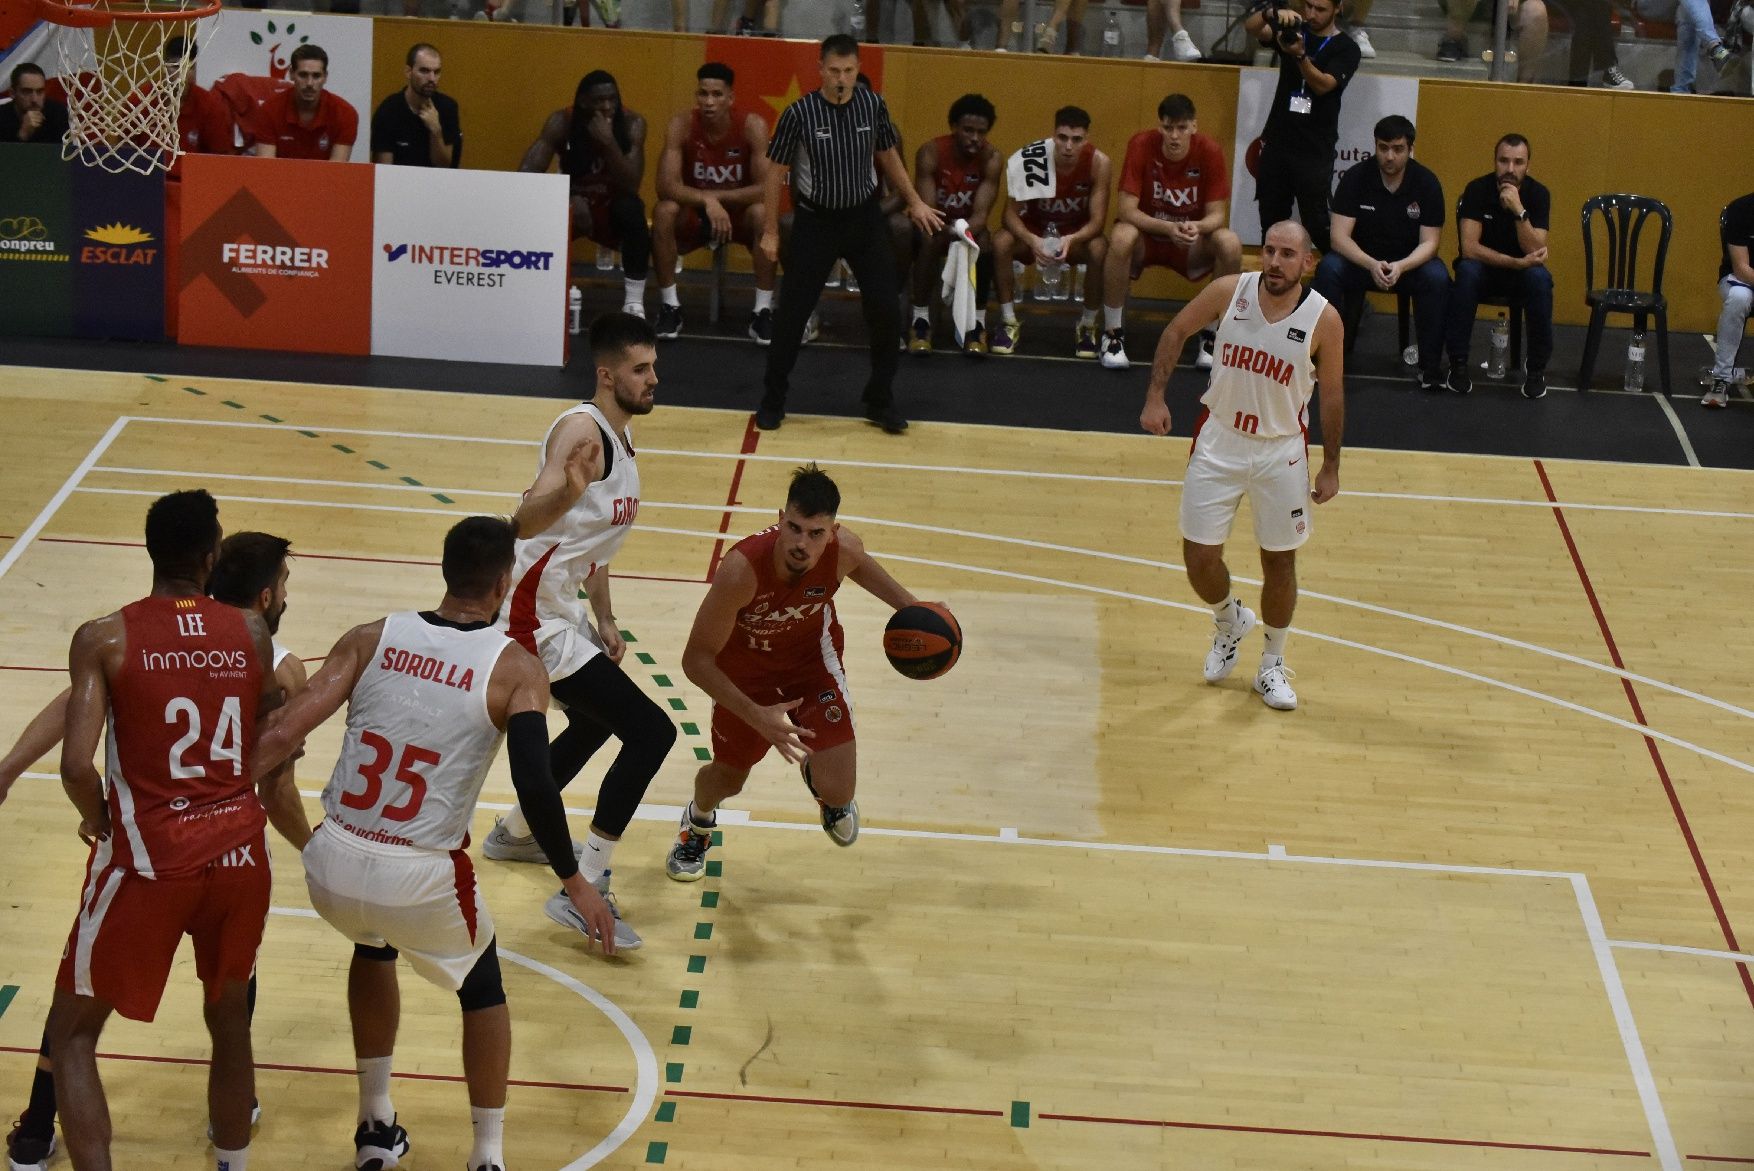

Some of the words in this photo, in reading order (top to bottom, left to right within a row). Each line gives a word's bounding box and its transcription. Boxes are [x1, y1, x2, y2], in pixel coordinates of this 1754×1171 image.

[693, 161, 743, 184] BAXI
[938, 188, 973, 209] BAX
[1153, 181, 1199, 207] BAXI
[0, 240, 55, 251] onpreu
[81, 247, 156, 265] ESCLAT
[222, 243, 329, 269] FERRER
[411, 244, 553, 270] INTERSPORT
[232, 267, 266, 275] ALIMENTS
[434, 270, 506, 287] EVEREST
[1222, 343, 1294, 387] GIRONA
[1234, 411, 1259, 435] 10
[611, 496, 639, 526] GIRO
[176, 613, 206, 636] LEE
[748, 635, 772, 652] 11
[142, 649, 247, 671] inmoovs
[381, 647, 474, 692] SOROLLA
[209, 671, 219, 679] by
[165, 696, 242, 780] 24
[340, 729, 442, 822] 35
